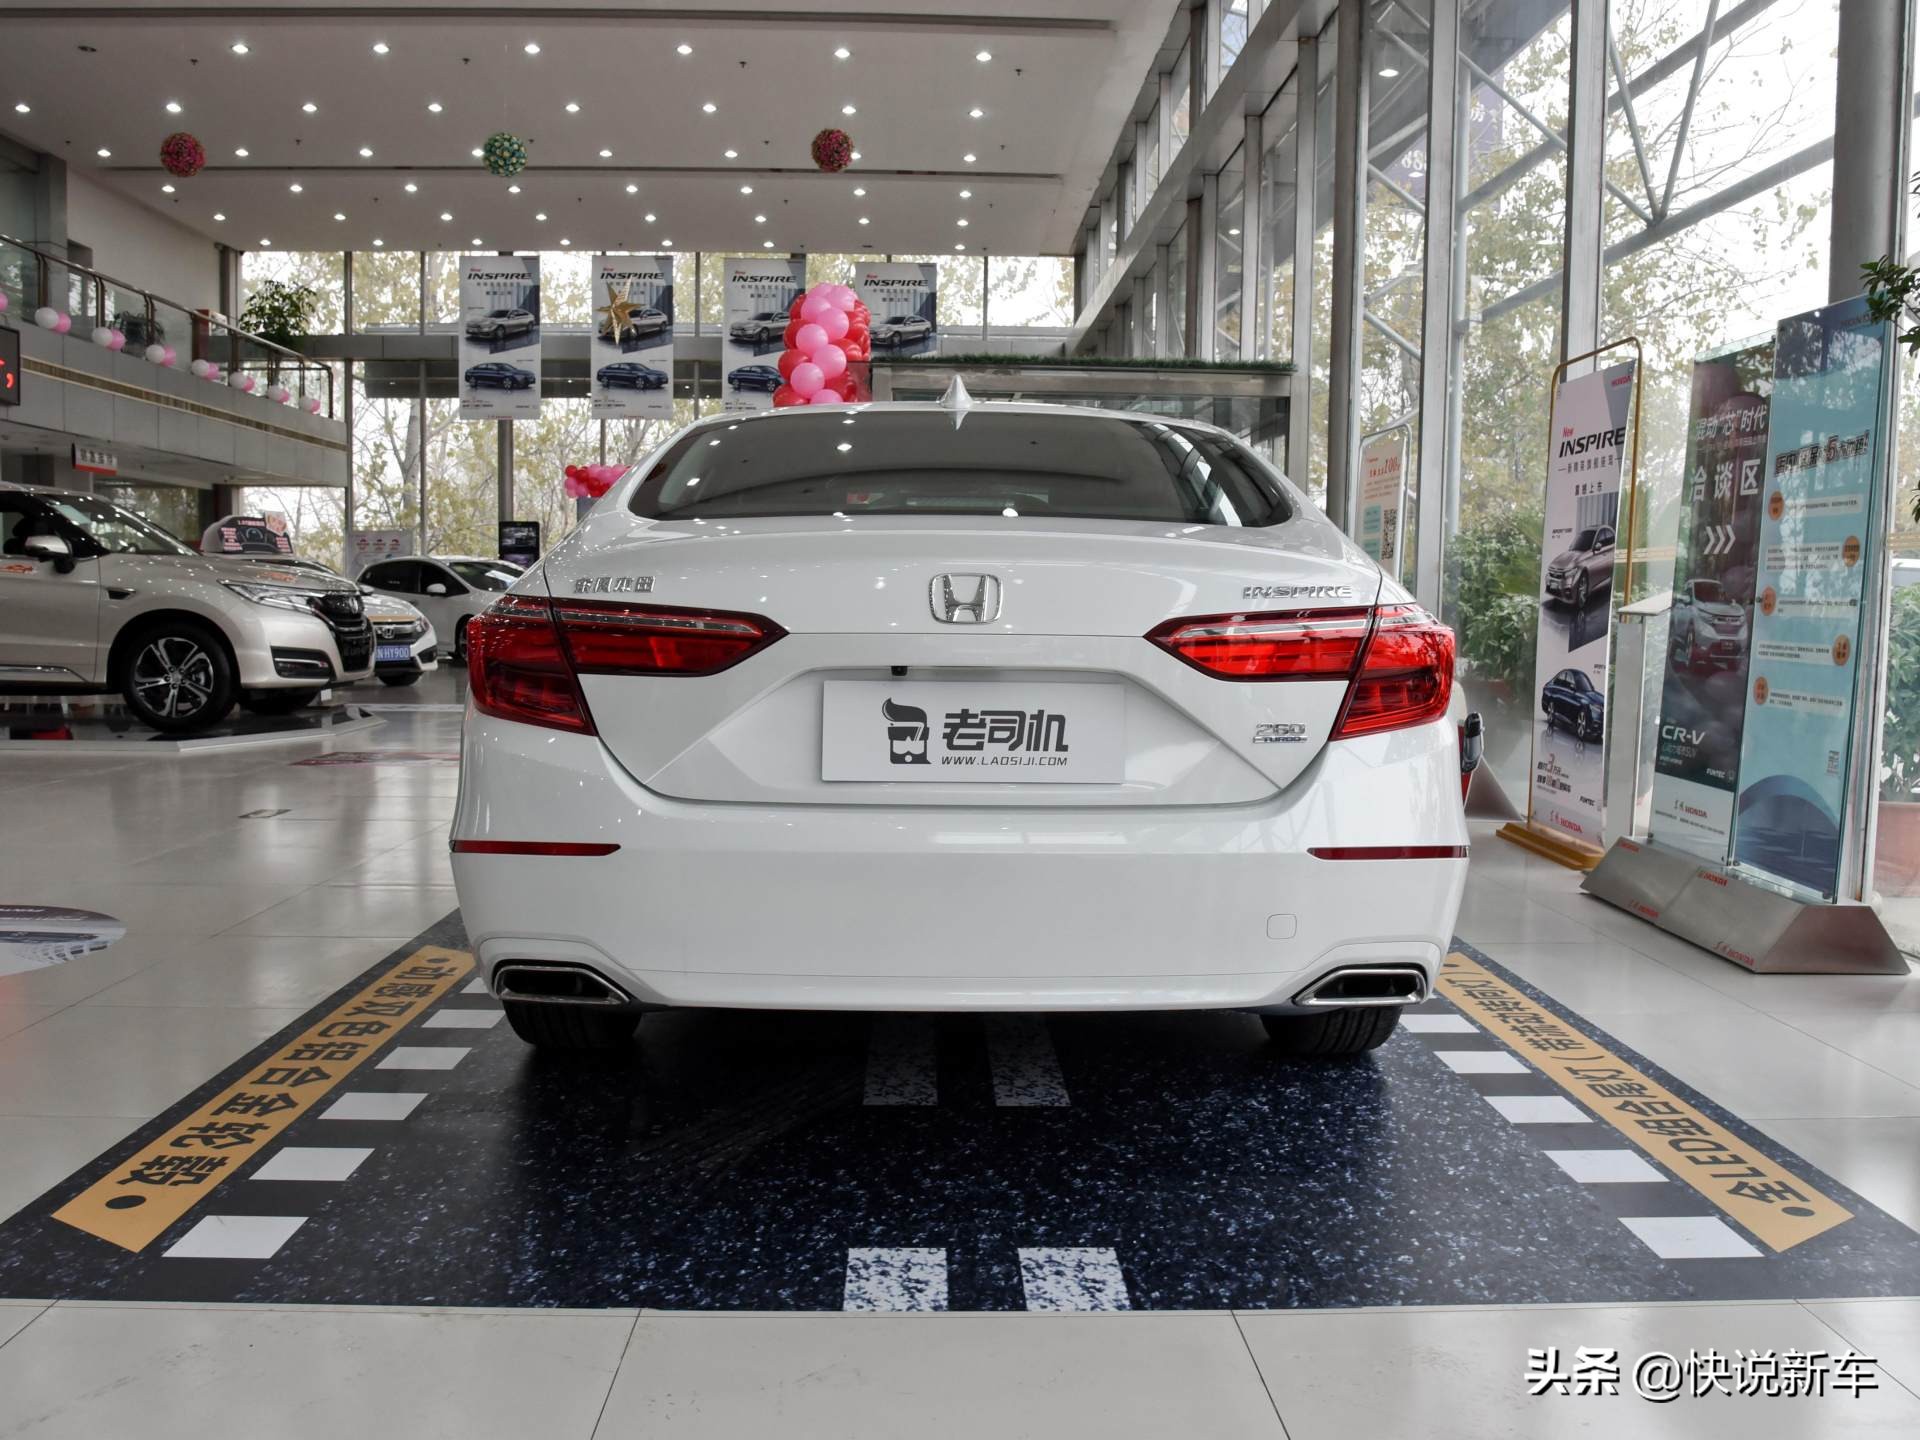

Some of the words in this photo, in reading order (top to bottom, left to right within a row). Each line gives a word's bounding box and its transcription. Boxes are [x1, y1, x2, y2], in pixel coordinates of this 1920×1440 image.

[467, 272, 532, 280] INSPIRE
[600, 272, 664, 280] INSPIRE
[732, 275, 797, 283] INSPIRE
[864, 279, 928, 287] INSPIRE
[1562, 427, 1574, 438] New
[1559, 426, 1626, 458] INSPIRE
[1242, 585, 1353, 600] INSPIRE
[942, 708, 1069, 752] 老司机
[1255, 723, 1306, 737] 260
[1661, 725, 1706, 745] CR-V
[941, 756, 1068, 766] WWW.LAOSIJI.COM
[1559, 817, 1583, 834] HONDA
